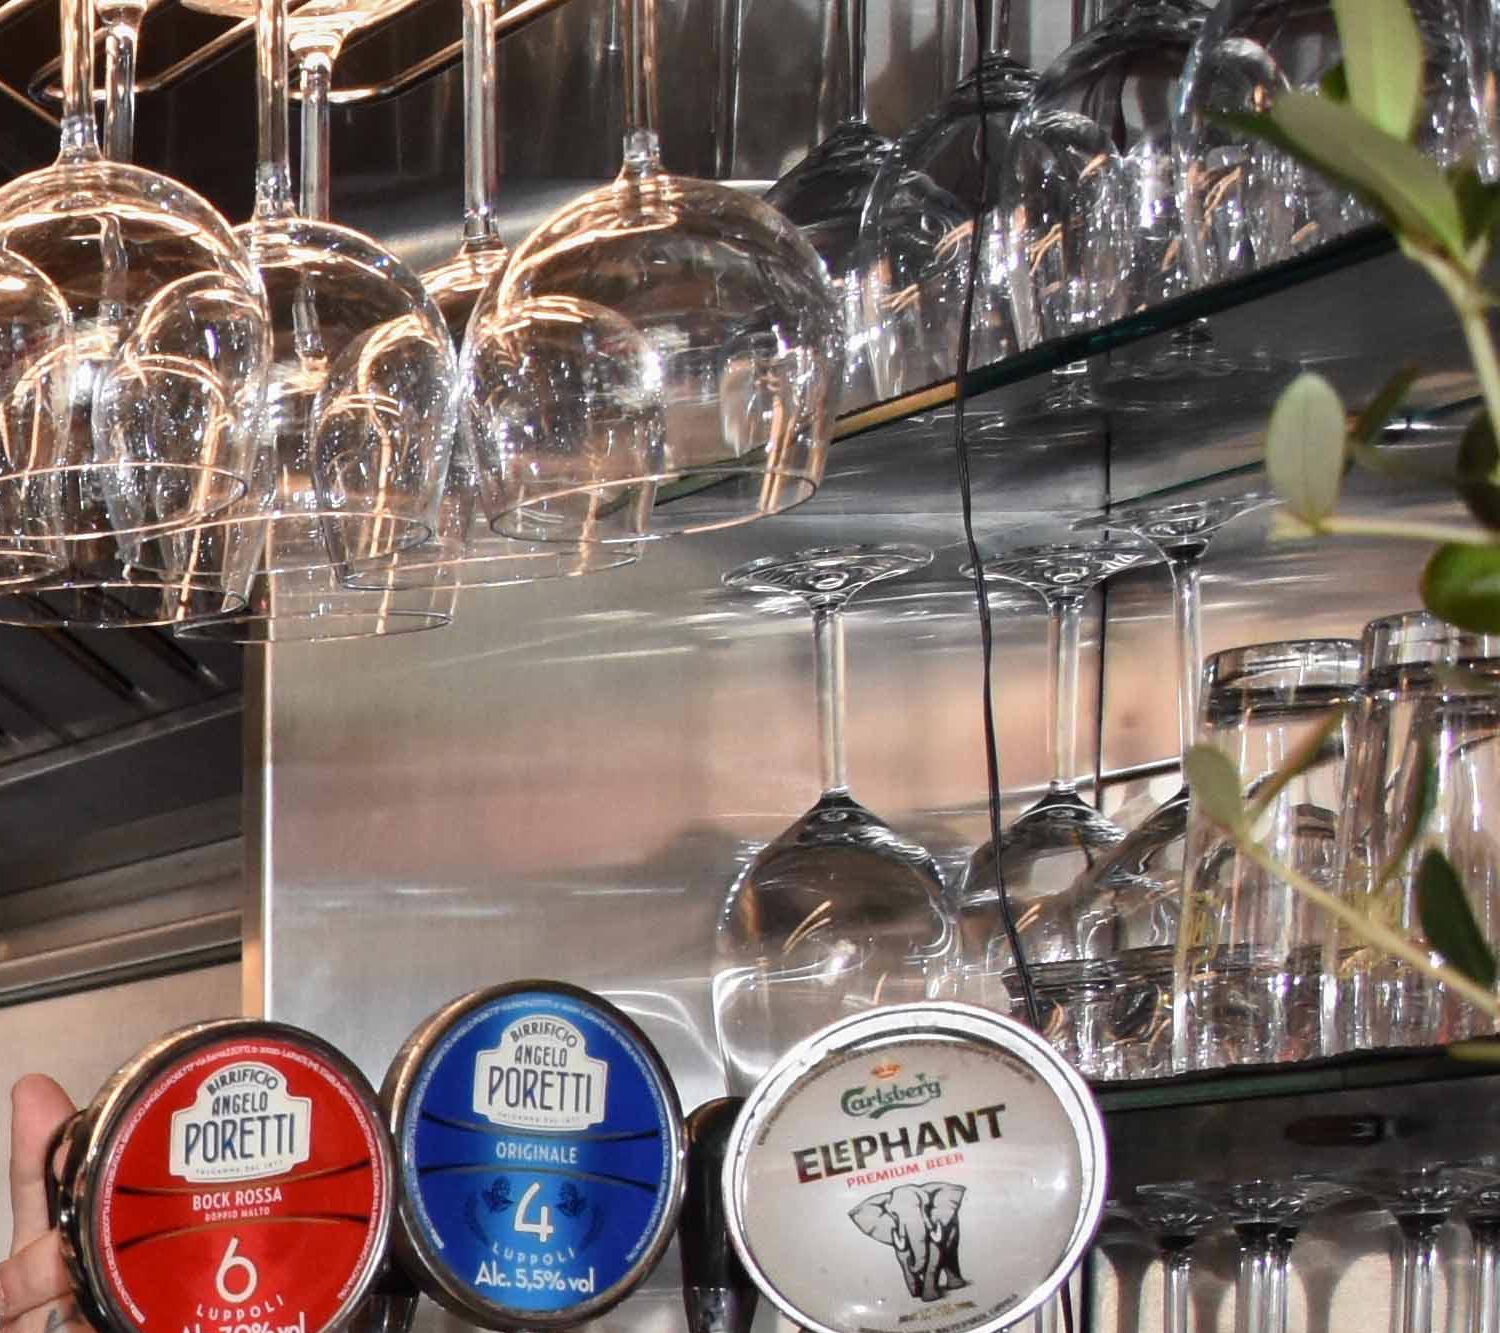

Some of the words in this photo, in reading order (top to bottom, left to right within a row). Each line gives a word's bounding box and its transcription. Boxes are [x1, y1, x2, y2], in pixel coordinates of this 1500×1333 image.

[510, 1021, 578, 1048] BIRRIFICIO
[514, 1045, 568, 1068] ANGELO
[206, 1067, 279, 1096] BIRRIFICIO
[488, 1066, 592, 1114] PORETTI
[840, 1073, 943, 1120] Carlsberg
[211, 1090, 268, 1117] ANGELO
[184, 1112, 296, 1166] PORETTI
[496, 1142, 578, 1164] ORIGINALE
[792, 1104, 1007, 1184] ELEPHANT
[845, 1164, 921, 1190] PREMIUM
[925, 1152, 965, 1173] BEER
[192, 1190, 231, 1211] BOCK
[235, 1187, 283, 1205] ROSSA
[514, 1182, 554, 1243] 4
[492, 1241, 576, 1265] LUPPOLI
[216, 1236, 259, 1303] 6
[474, 1261, 511, 1287] Alc.
[515, 1268, 566, 1291] 5,5%
[566, 1267, 595, 1294] vol
[196, 1294, 285, 1321] LUPPOLI
